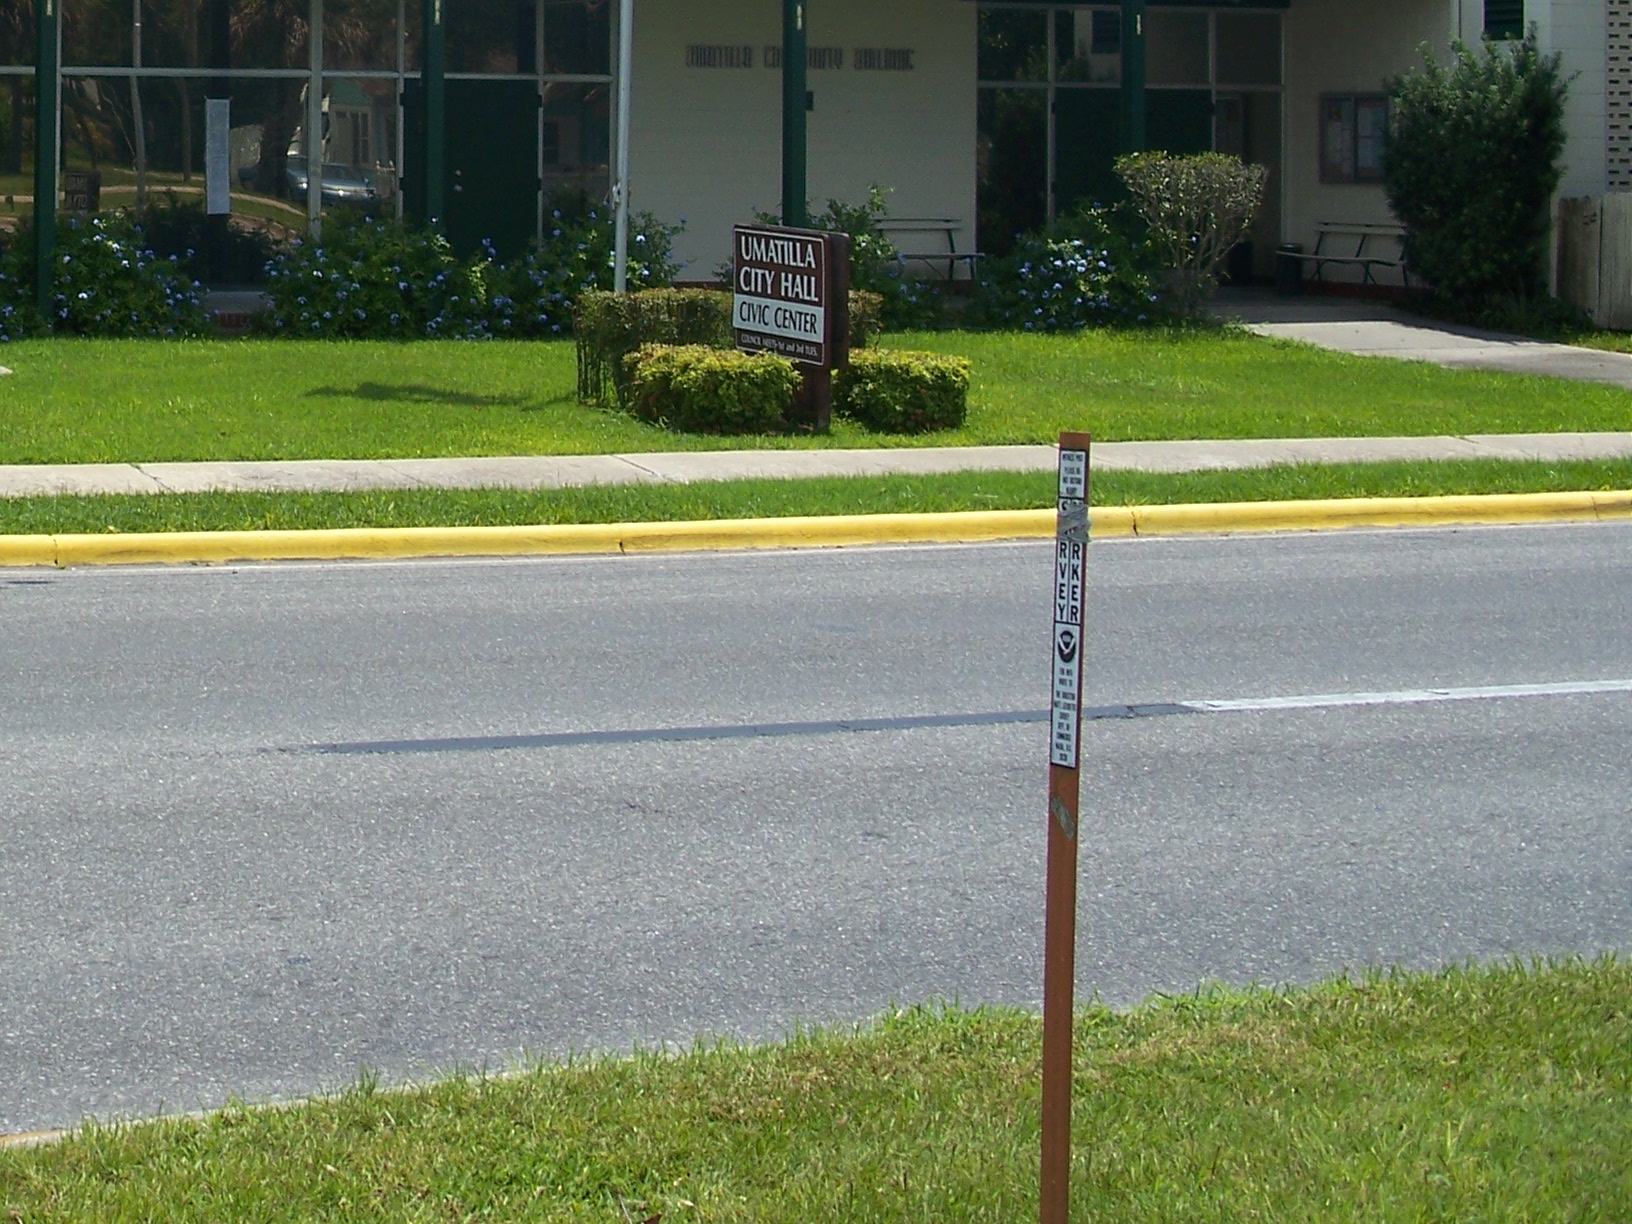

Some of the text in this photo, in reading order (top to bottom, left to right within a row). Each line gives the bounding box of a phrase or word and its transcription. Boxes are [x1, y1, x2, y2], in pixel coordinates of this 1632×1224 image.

[740, 235, 816, 269] UMATILLA
[739, 266, 818, 302] CITY HALL
[739, 301, 817, 334] CIVIC CENTER
[1057, 500, 1068, 620] RVEY
